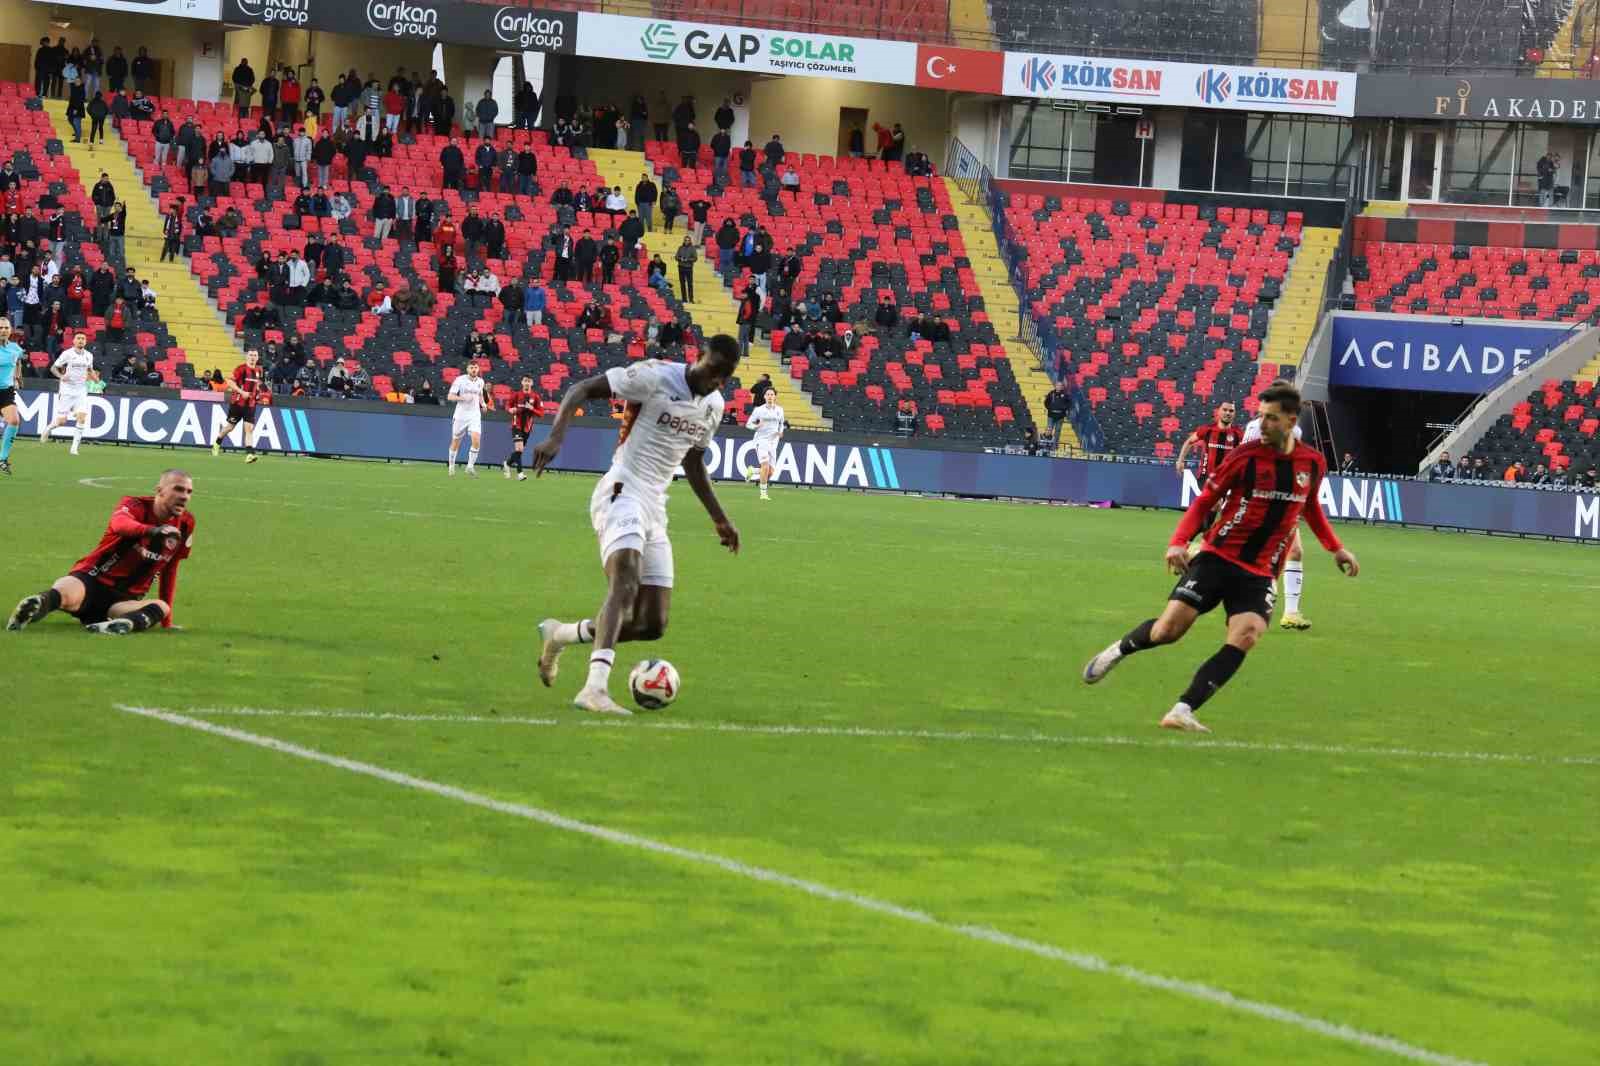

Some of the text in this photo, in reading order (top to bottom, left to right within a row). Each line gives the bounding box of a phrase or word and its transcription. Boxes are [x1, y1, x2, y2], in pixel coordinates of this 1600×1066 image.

[264, 7, 309, 26] group
[393, 20, 437, 38] group
[520, 33, 563, 50] group
[684, 29, 855, 64] GAP SOLAR
[1062, 61, 1163, 91] KÖKSAN
[1237, 72, 1339, 101] KÖKSAN
[1483, 98, 1600, 119] AKADE
[1139, 121, 1150, 136] H
